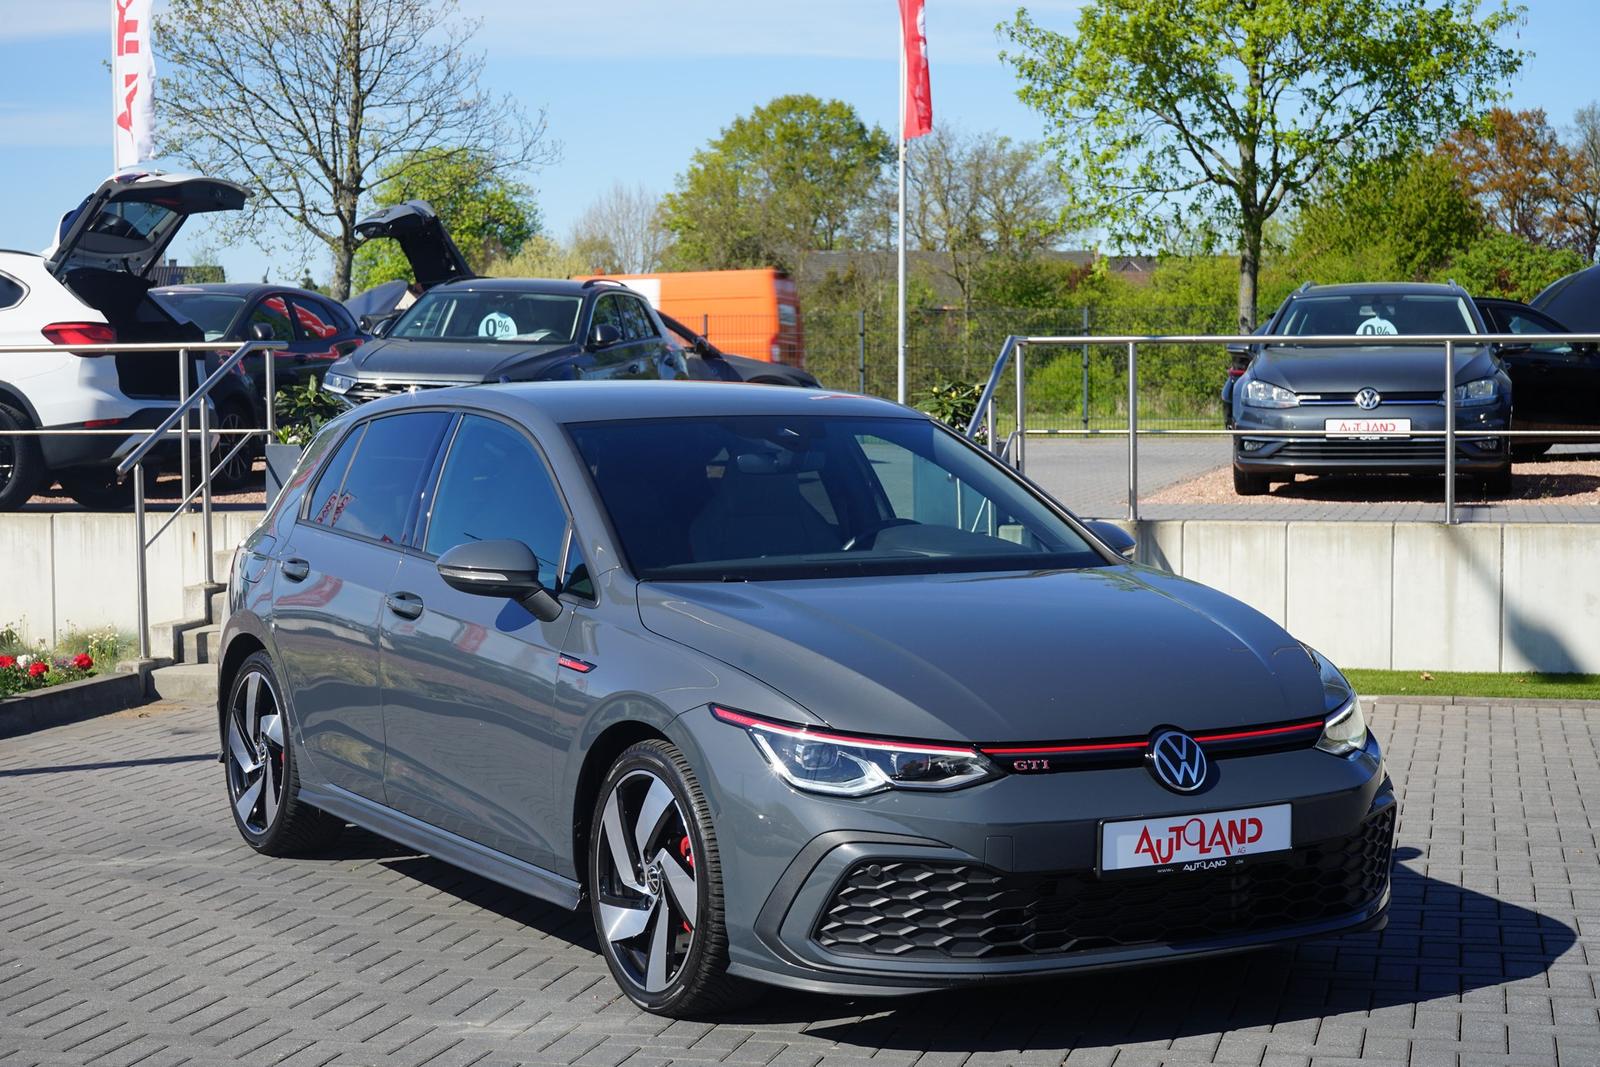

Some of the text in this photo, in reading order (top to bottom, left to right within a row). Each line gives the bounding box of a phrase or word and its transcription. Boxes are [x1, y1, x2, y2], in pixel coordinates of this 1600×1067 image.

[485, 318, 510, 337] 0%
[1013, 759, 1051, 771] GTI
[1134, 817, 1263, 864] AUTOLAND
[1237, 846, 1247, 854] AG
[1183, 860, 1228, 872] AUTOLAND
